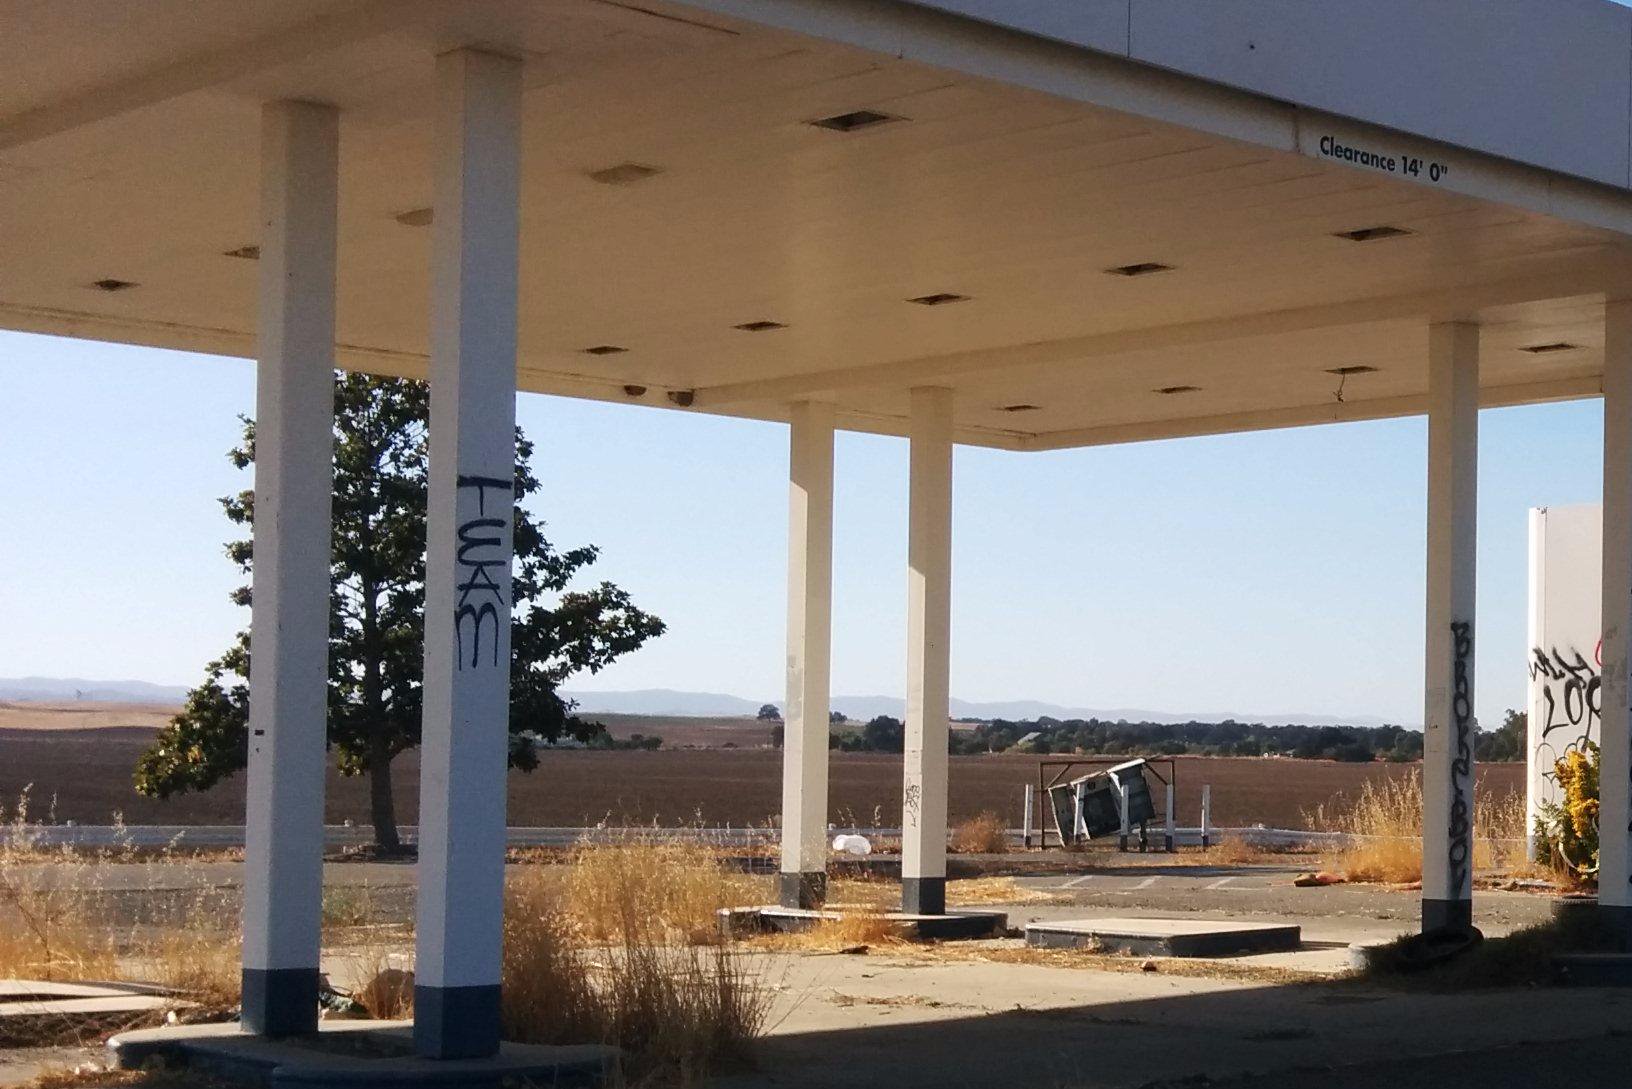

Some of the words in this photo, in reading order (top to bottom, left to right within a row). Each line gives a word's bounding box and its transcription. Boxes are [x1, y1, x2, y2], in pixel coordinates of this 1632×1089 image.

[1320, 136, 1396, 171] Clearance
[1402, 156, 1423, 177] 14'
[1429, 163, 1448, 182] 0"
